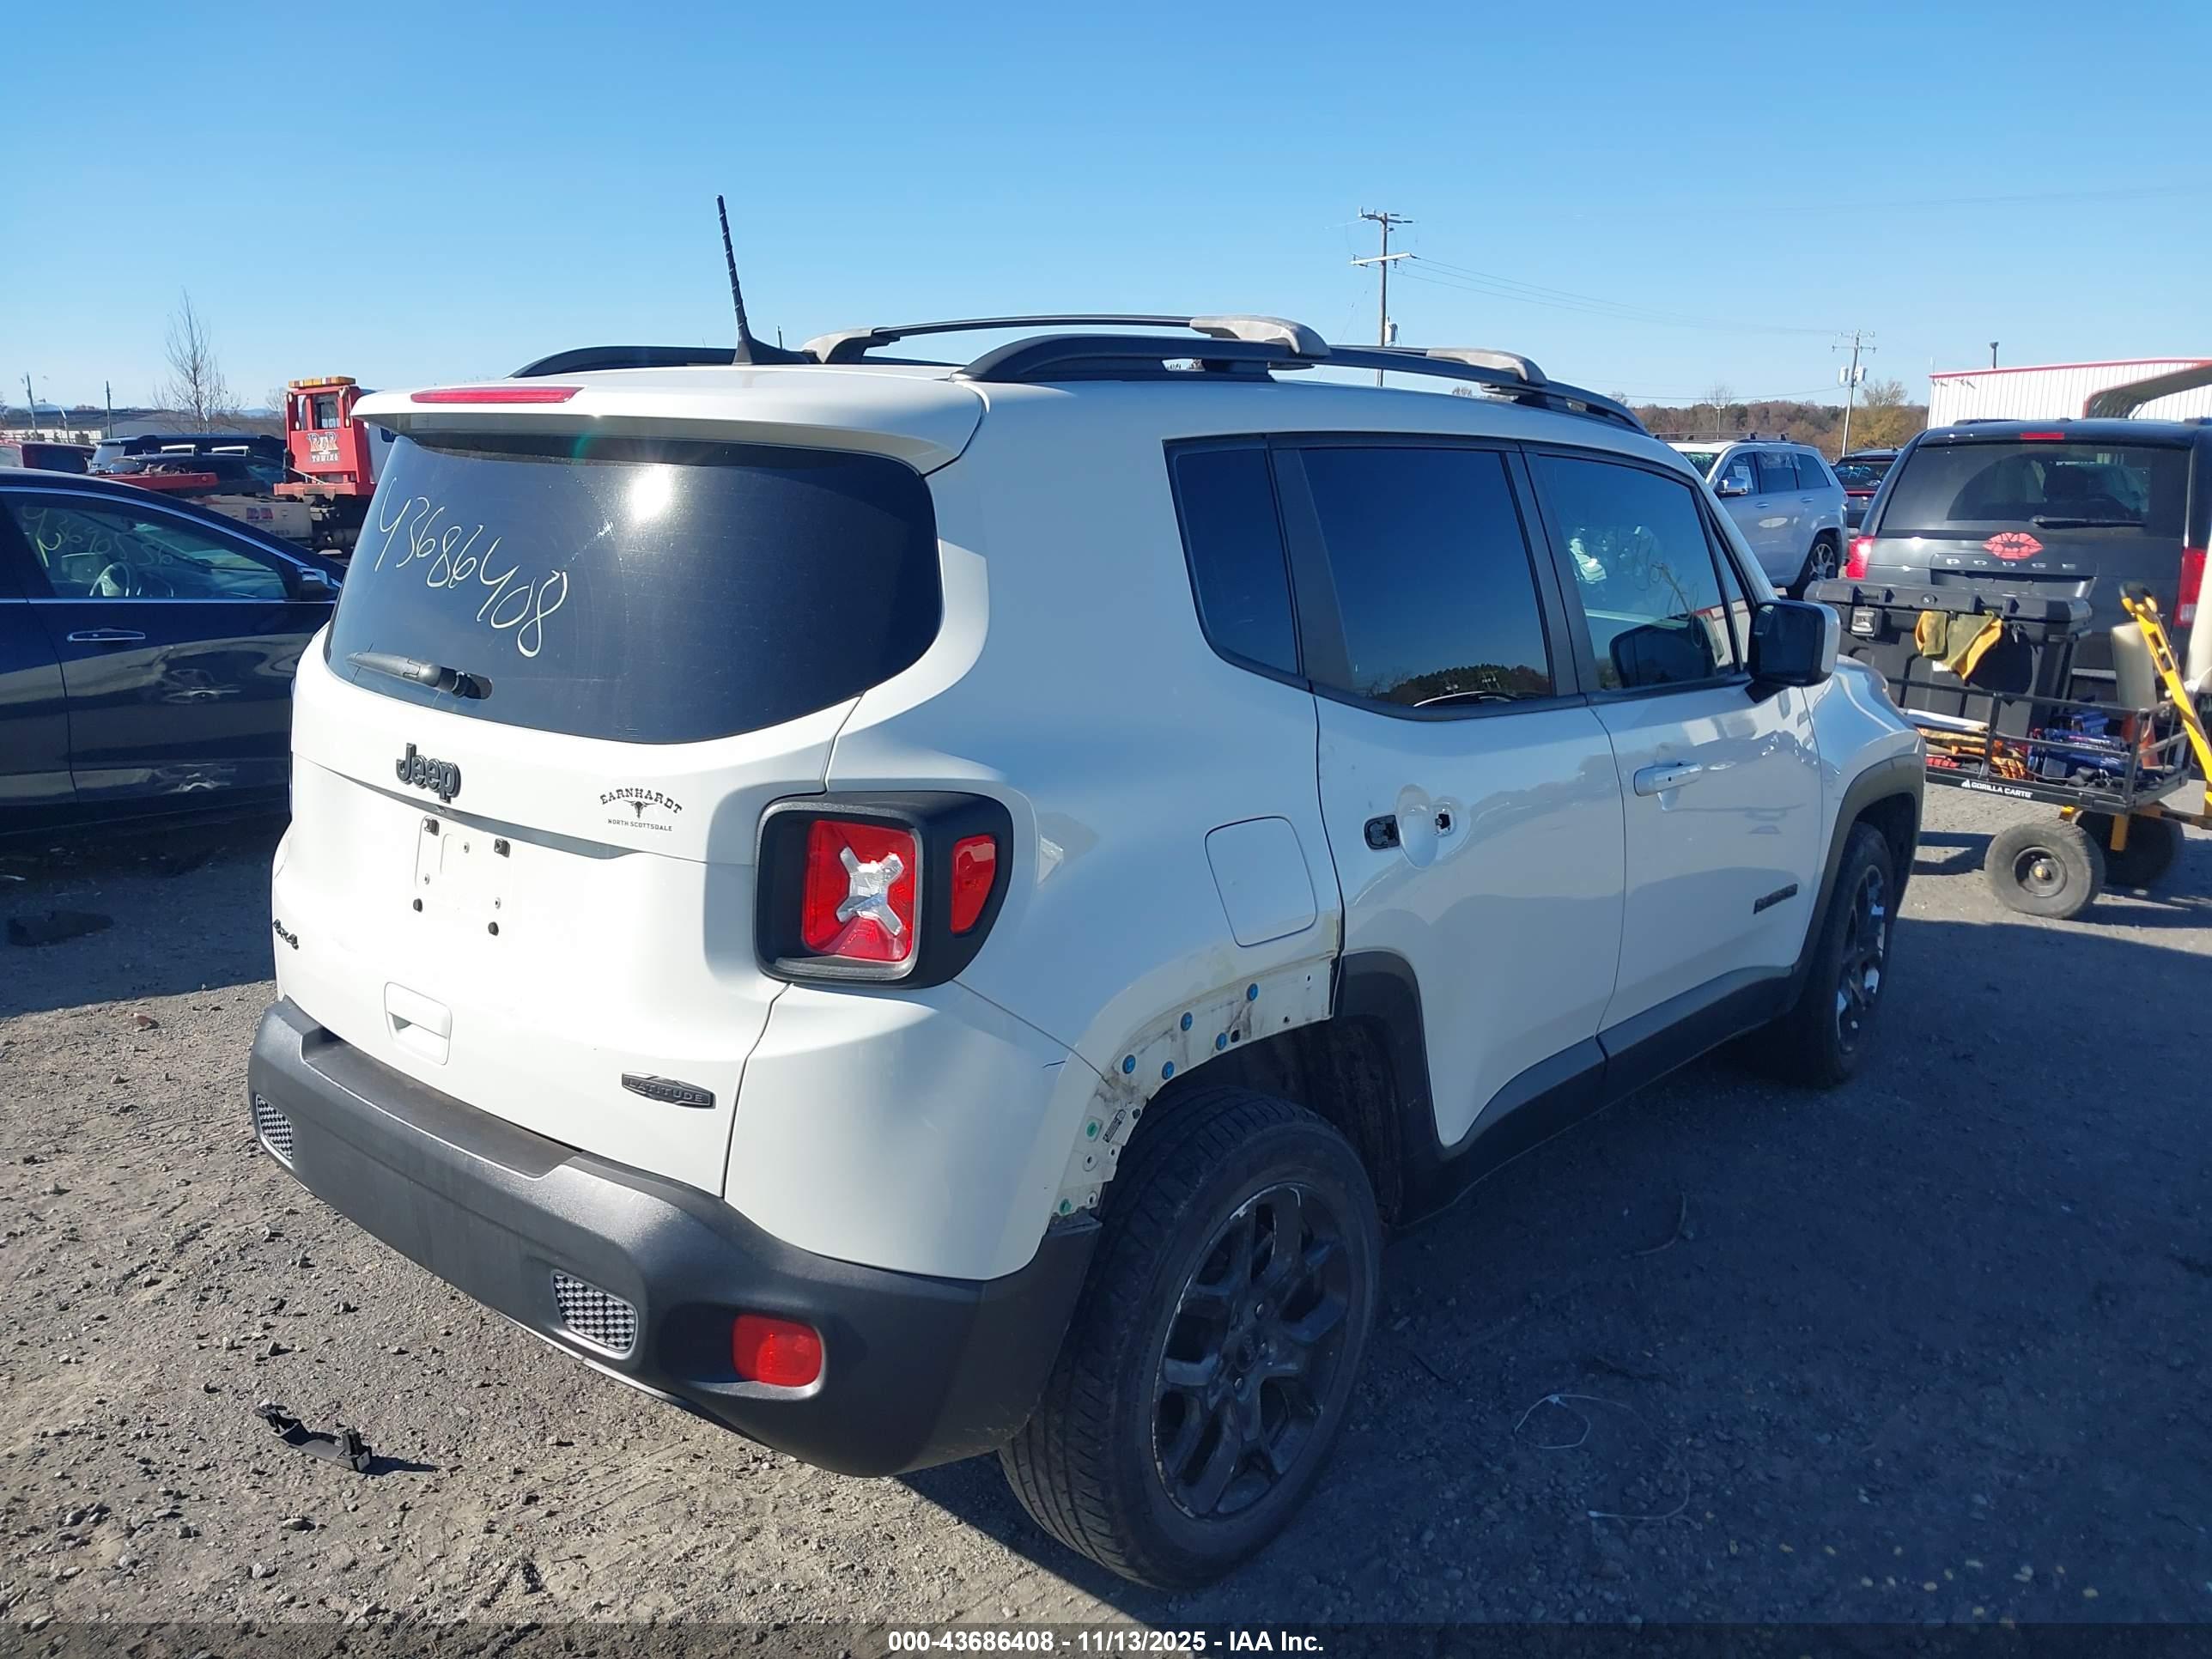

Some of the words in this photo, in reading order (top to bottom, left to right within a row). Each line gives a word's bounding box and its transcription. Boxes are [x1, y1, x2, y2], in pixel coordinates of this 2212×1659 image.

[375, 477, 568, 658] 43686408
[1946, 558, 2076, 569] DODGE
[396, 743, 461, 804] Jeep
[600, 787, 683, 814] EARNHARDT
[1971, 781, 2003, 793] GORILLA
[2004, 787, 2033, 799] CARTS
[630, 821, 673, 832] SCOTTSDALE
[628, 1079, 703, 1103] LATITUDE
